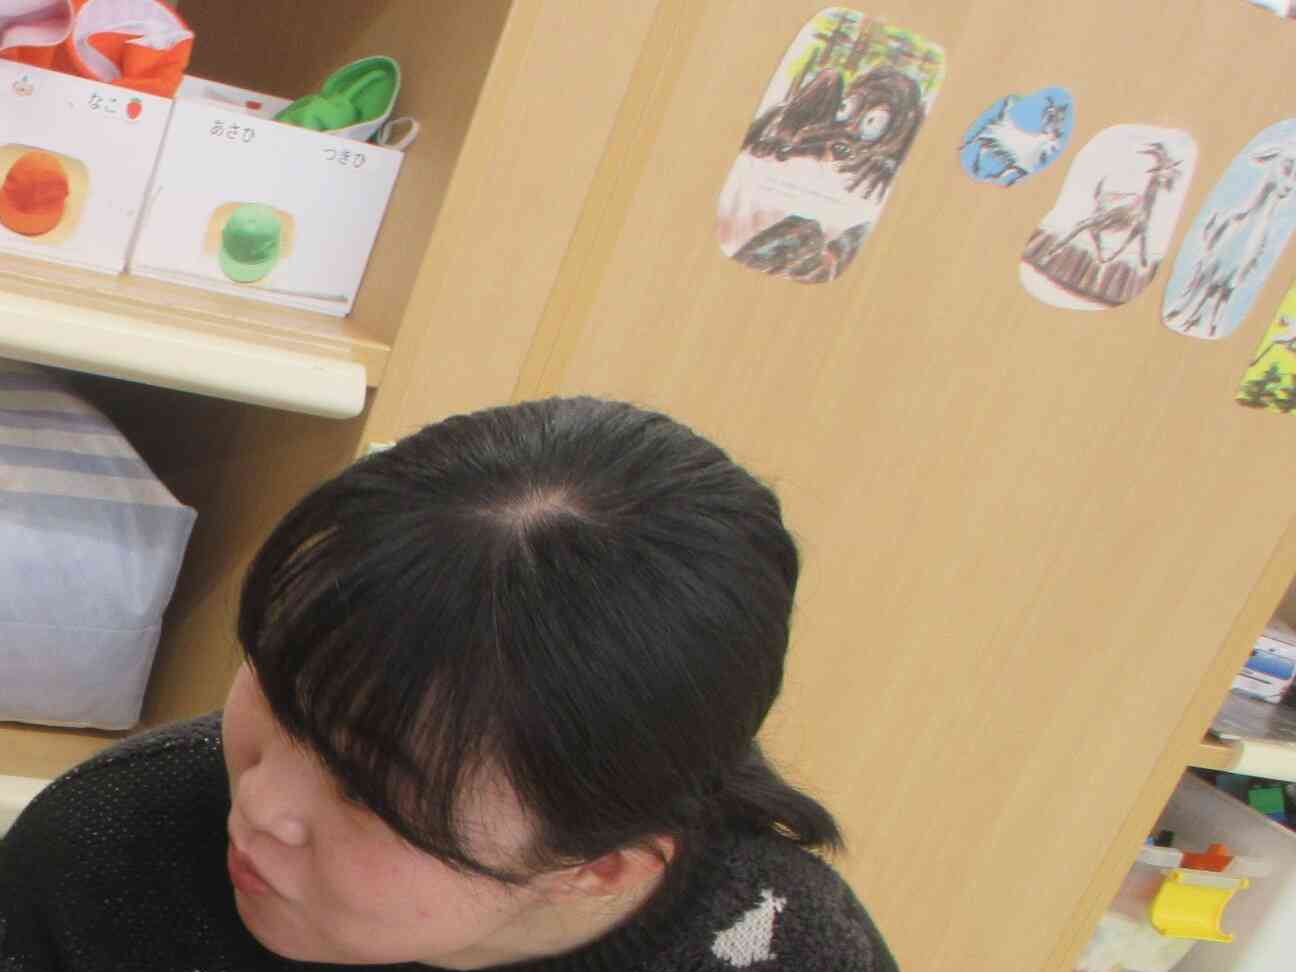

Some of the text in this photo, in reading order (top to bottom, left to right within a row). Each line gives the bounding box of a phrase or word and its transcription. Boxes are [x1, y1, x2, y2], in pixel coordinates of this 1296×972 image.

[209, 119, 256, 144] あさひ
[320, 147, 367, 169] つきひ
